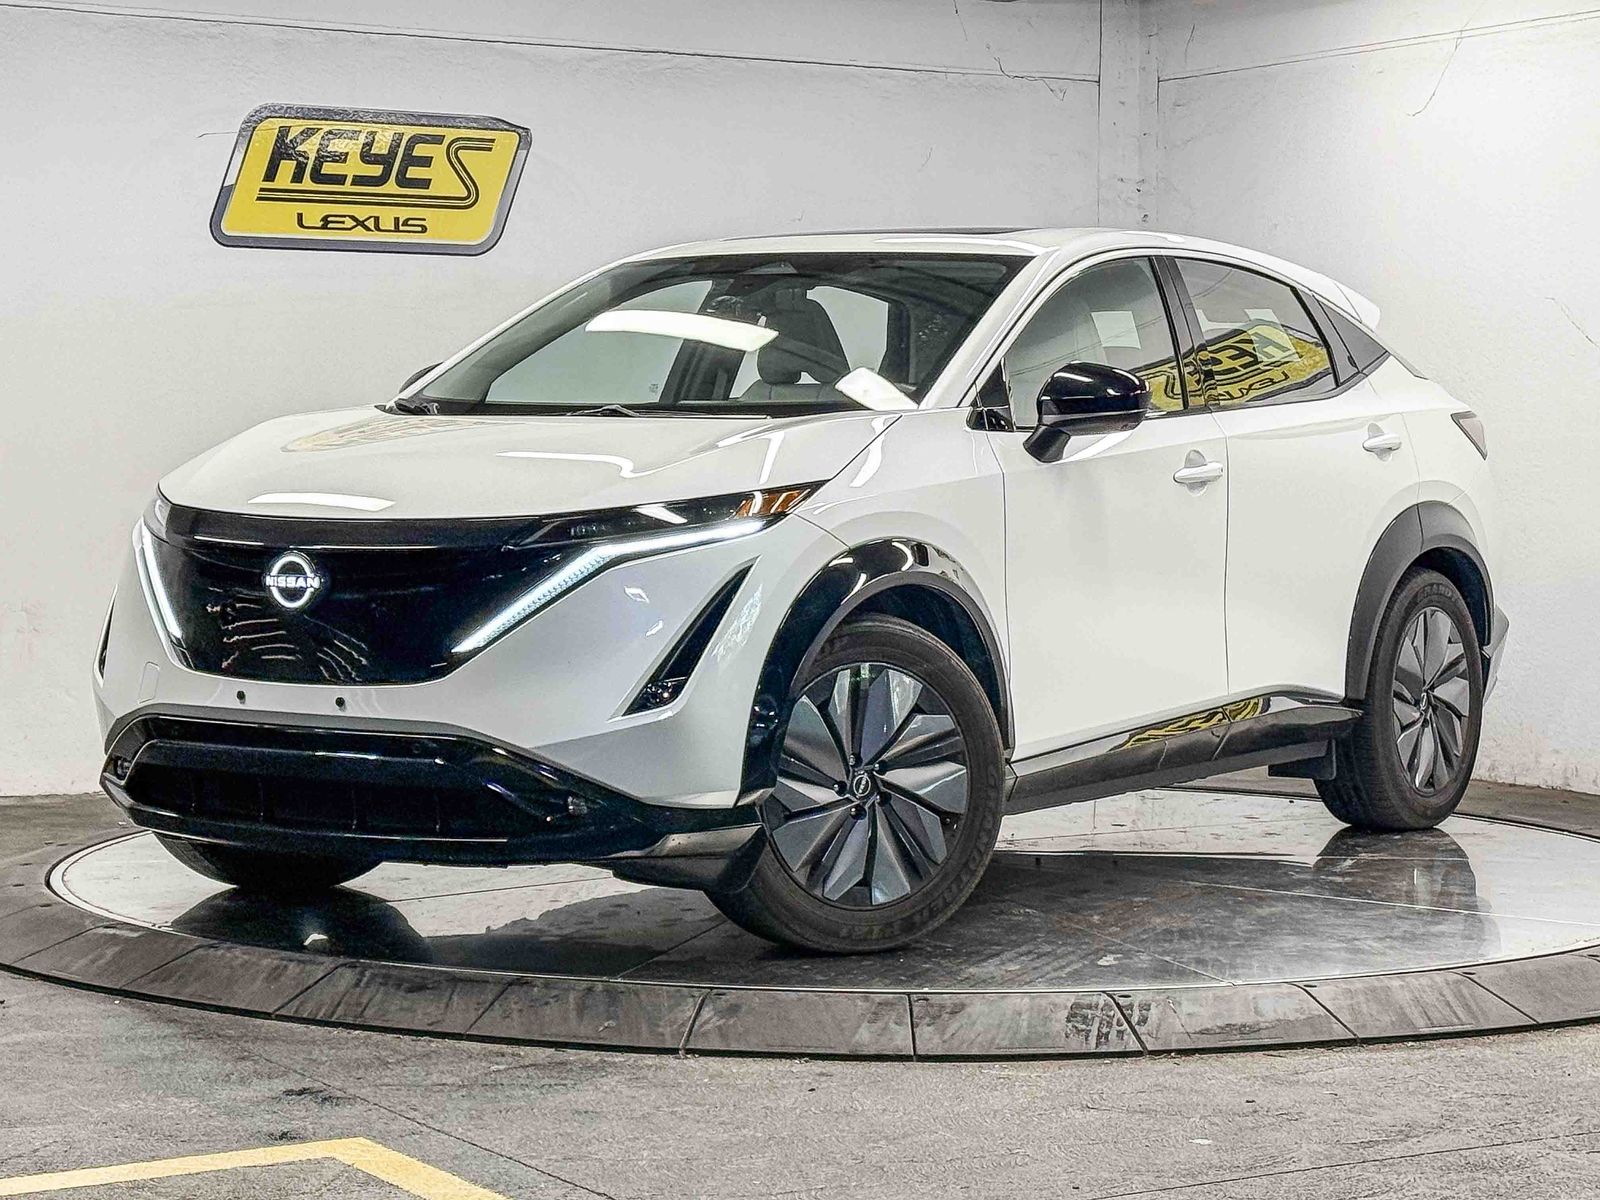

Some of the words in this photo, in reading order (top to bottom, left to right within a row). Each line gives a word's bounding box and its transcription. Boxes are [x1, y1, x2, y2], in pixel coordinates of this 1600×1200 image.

[257, 126, 496, 209] KEYES
[297, 212, 428, 233] LEXUS
[265, 575, 320, 589] NISSAN
